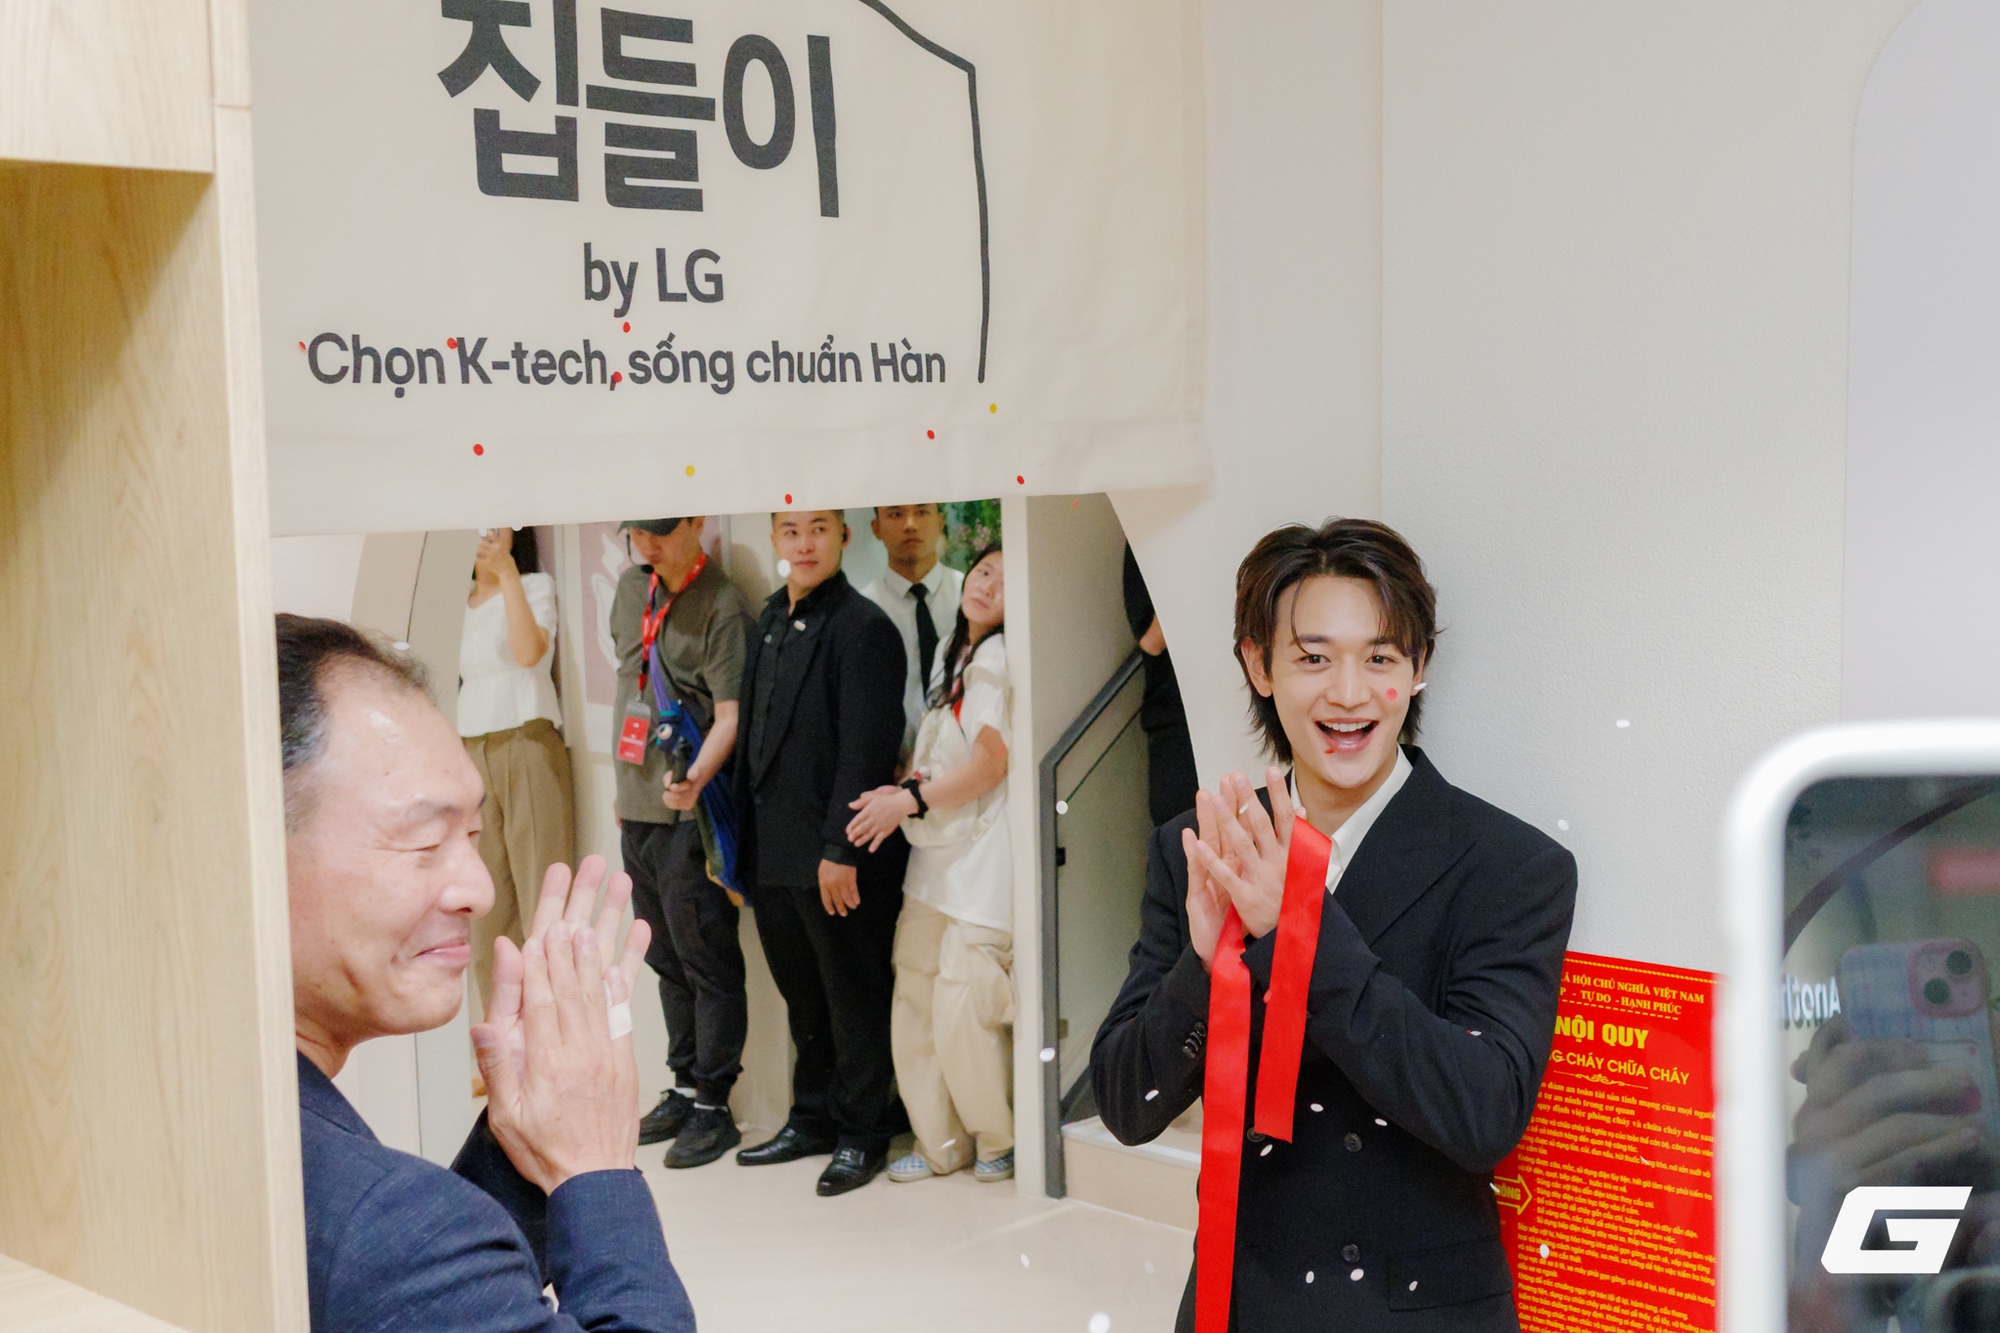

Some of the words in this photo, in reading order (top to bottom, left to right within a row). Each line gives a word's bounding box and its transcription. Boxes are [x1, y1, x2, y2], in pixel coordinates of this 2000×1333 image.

[437, 0, 840, 218] 집들이
[583, 242, 639, 318] by
[655, 247, 724, 304] LG
[307, 332, 446, 399] Chọn
[627, 332, 735, 395] sống
[746, 334, 863, 384] chuẩn
[870, 337, 946, 384] Hàn
[1572, 974, 1592, 987] HỘI
[1593, 978, 1616, 989] CHỦ
[1617, 981, 1651, 996] NGHĨA
[1653, 987, 1678, 1000] VIỆT
[1679, 991, 1705, 1004] NAM
[1580, 990, 1596, 1003] TỰ
[1596, 993, 1612, 1003] DO
[1620, 996, 1651, 1011] HẠNH
[1653, 1001, 1682, 1015] PHÚC
[1554, 1014, 1594, 1043] NỘI
[1601, 1023, 1649, 1050] QUY
[1566, 1052, 1605, 1070] CHÁY
[1607, 1059, 1647, 1078] CHỮA
[1649, 1067, 1690, 1085] CHÁY
